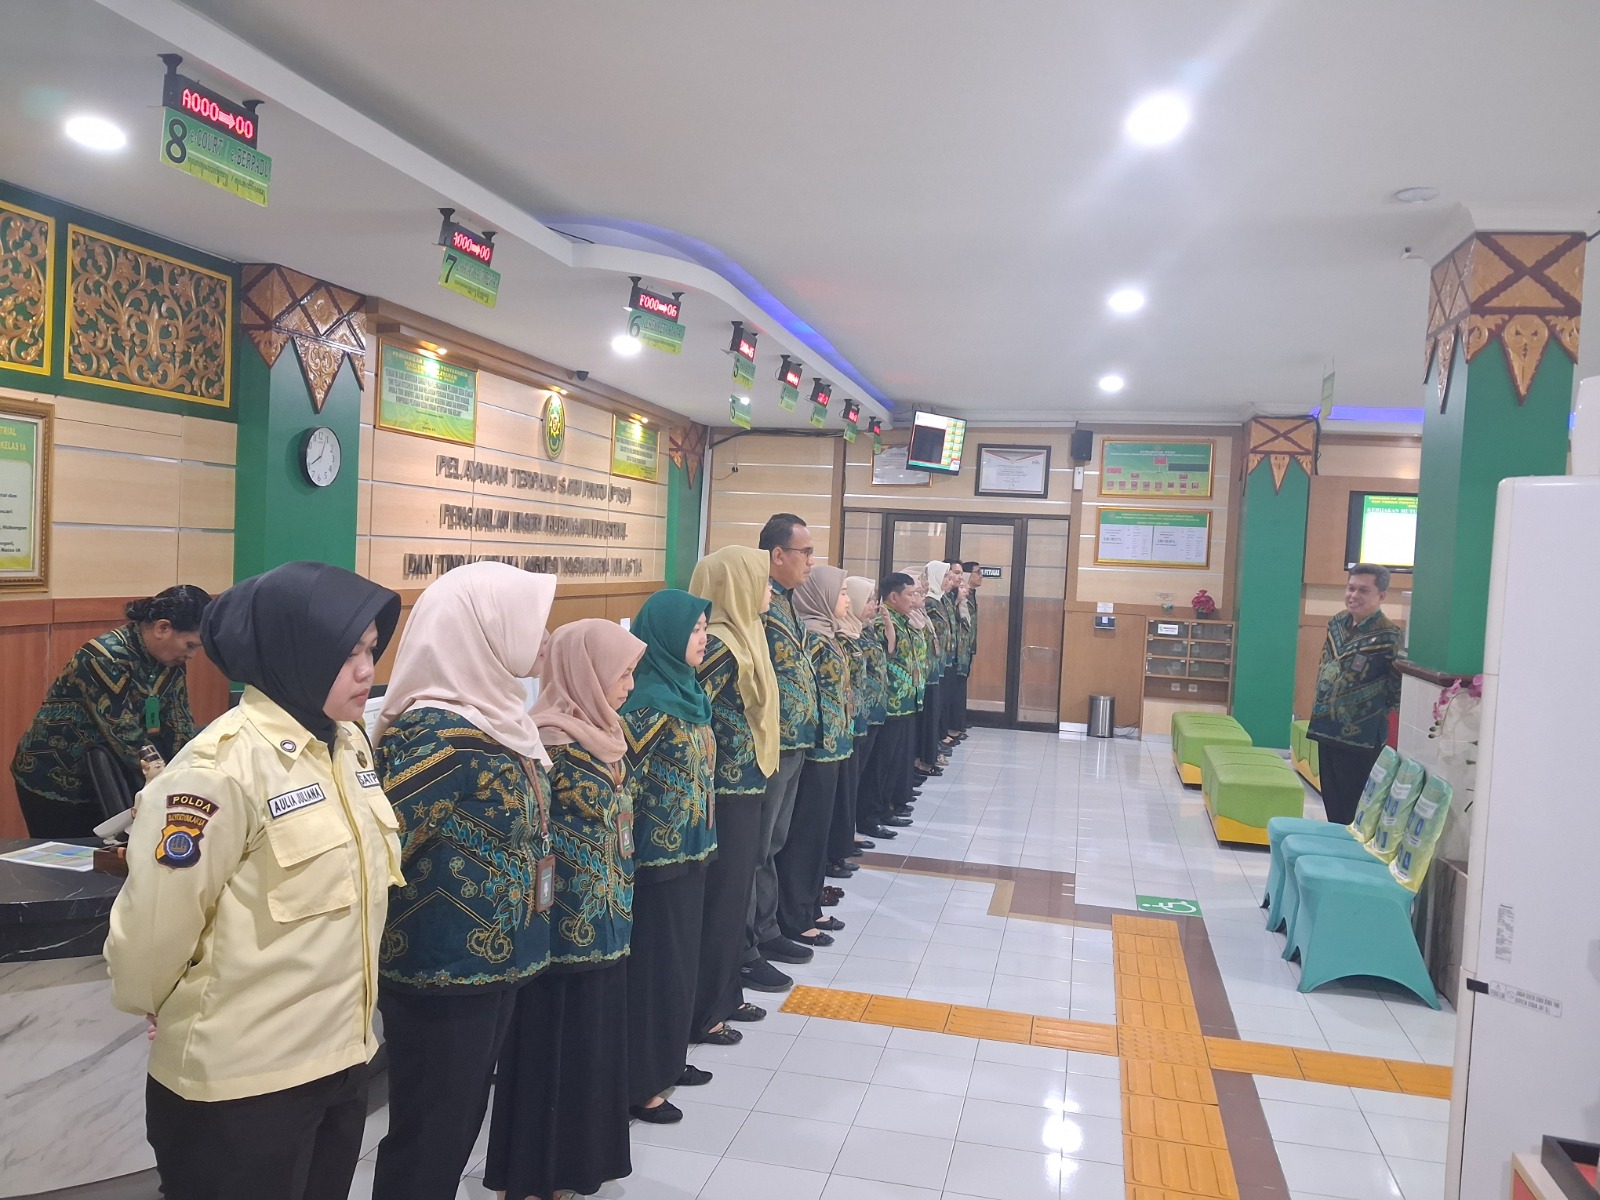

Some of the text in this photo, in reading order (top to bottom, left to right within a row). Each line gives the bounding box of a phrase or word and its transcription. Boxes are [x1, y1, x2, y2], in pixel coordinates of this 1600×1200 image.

[165, 118, 188, 164] 8
[446, 253, 458, 284] 7
[629, 315, 642, 338] 6
[172, 796, 211, 813] POLDA
[274, 786, 322, 814] AULIA JULIANA
